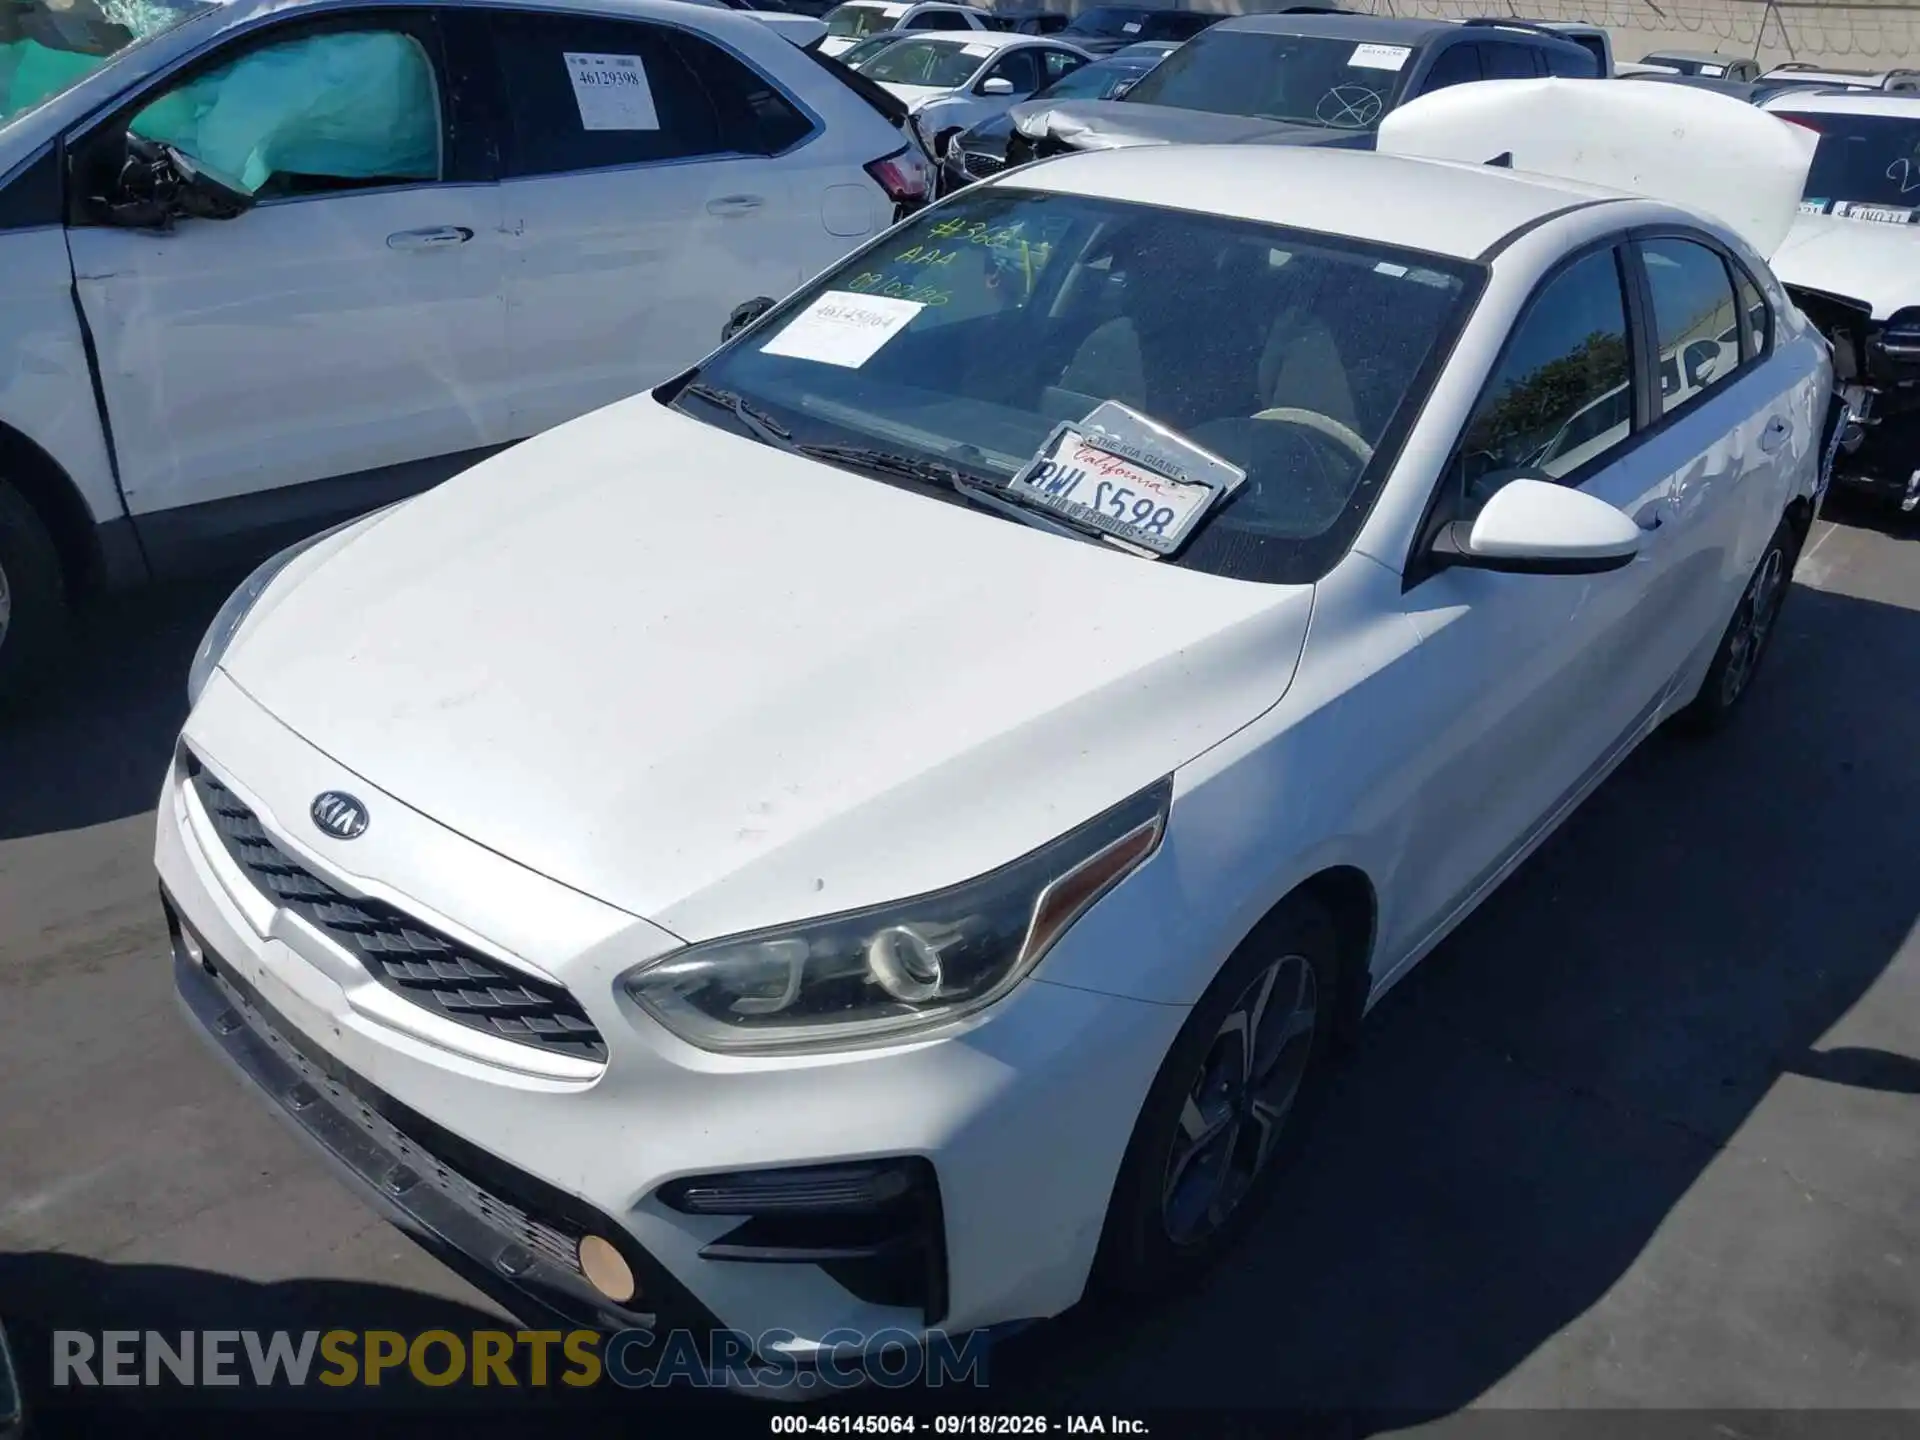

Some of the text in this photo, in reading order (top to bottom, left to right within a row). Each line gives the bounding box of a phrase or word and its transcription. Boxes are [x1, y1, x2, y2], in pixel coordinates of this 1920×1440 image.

[579, 71, 640, 86] 46129398
[894, 246, 957, 265] AAA
[1072, 444, 1167, 496] California
[1096, 437, 1184, 476] THE KIA GIANT
[314, 792, 359, 834] KIA
